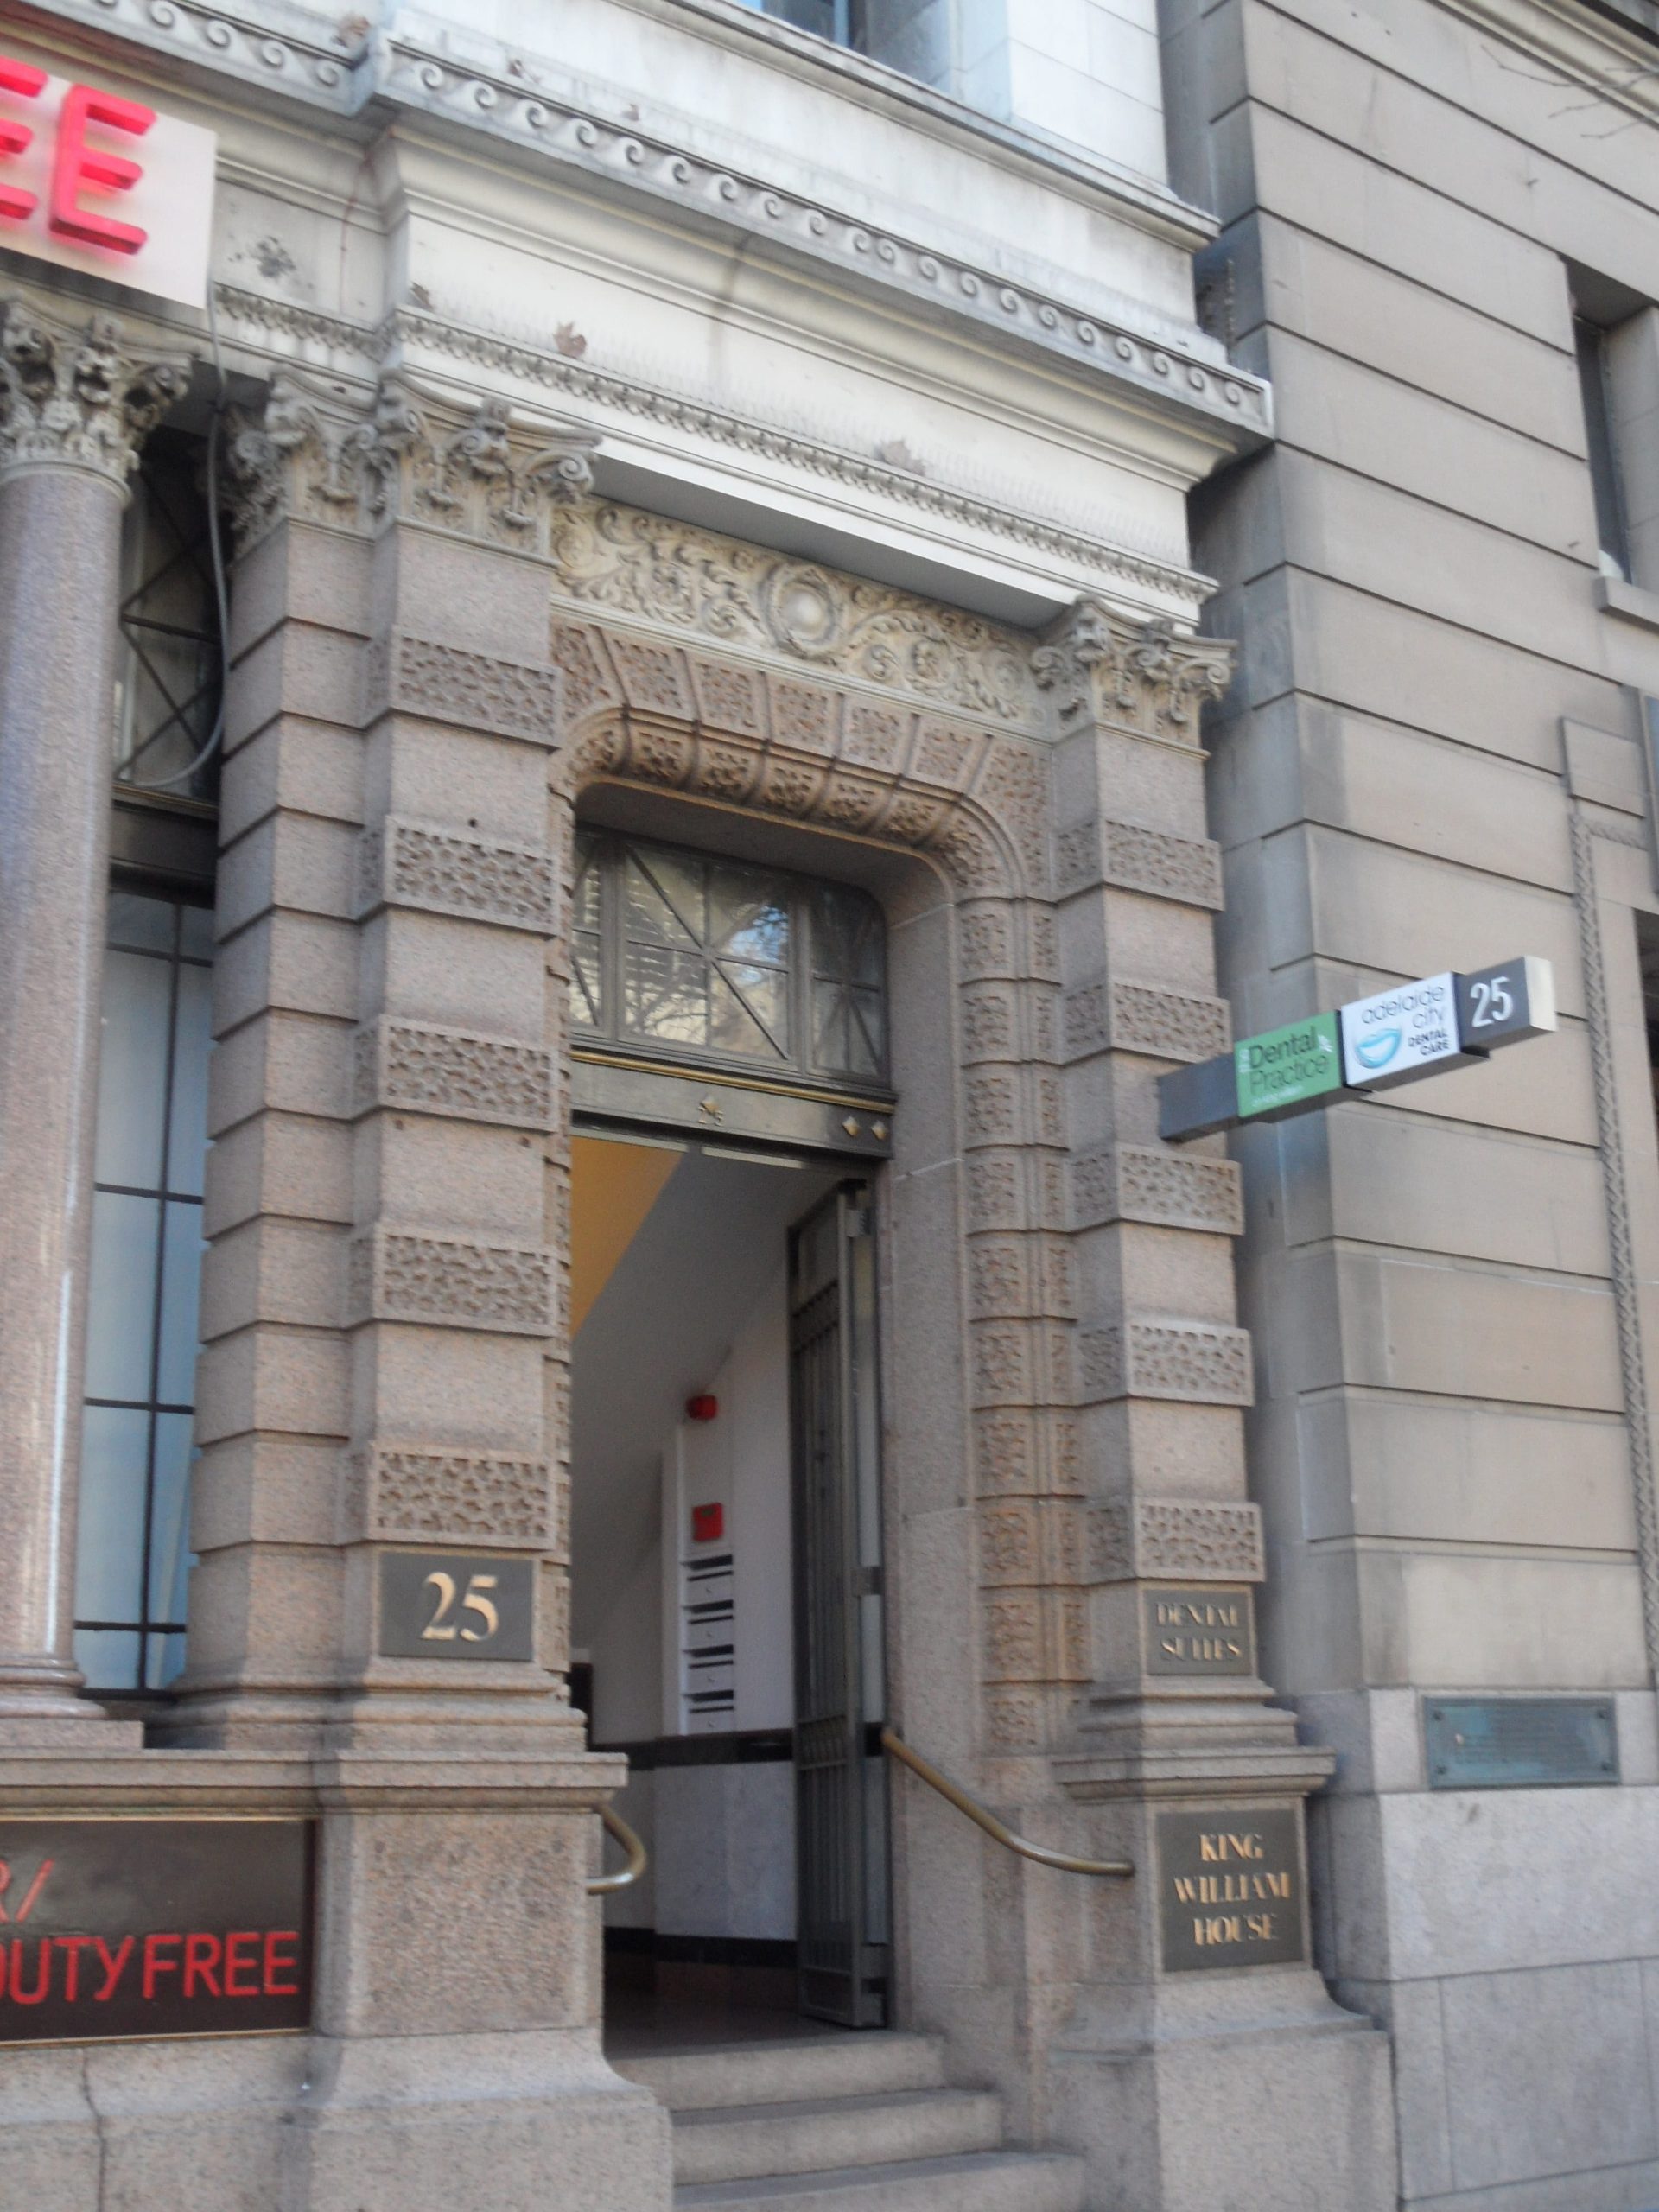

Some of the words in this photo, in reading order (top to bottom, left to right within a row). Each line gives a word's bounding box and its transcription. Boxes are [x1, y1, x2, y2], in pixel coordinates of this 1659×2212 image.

[1361, 985, 1444, 1024] adelaide
[1413, 1003, 1445, 1029] city
[1471, 976, 1513, 1027] 25
[1249, 1025, 1317, 1069] Dental
[1408, 1028, 1448, 1047] DENTAL
[1420, 1041, 1450, 1056] CARE
[1249, 1055, 1327, 1096] Practice
[421, 1572, 499, 1642] 25
[1199, 1834, 1264, 1861] KING
[1173, 1872, 1291, 1904] WILLIAM
[1193, 1913, 1279, 1946] HOUSE
[0, 1935, 135, 2005] UTY
[142, 1931, 300, 1999] FREE
